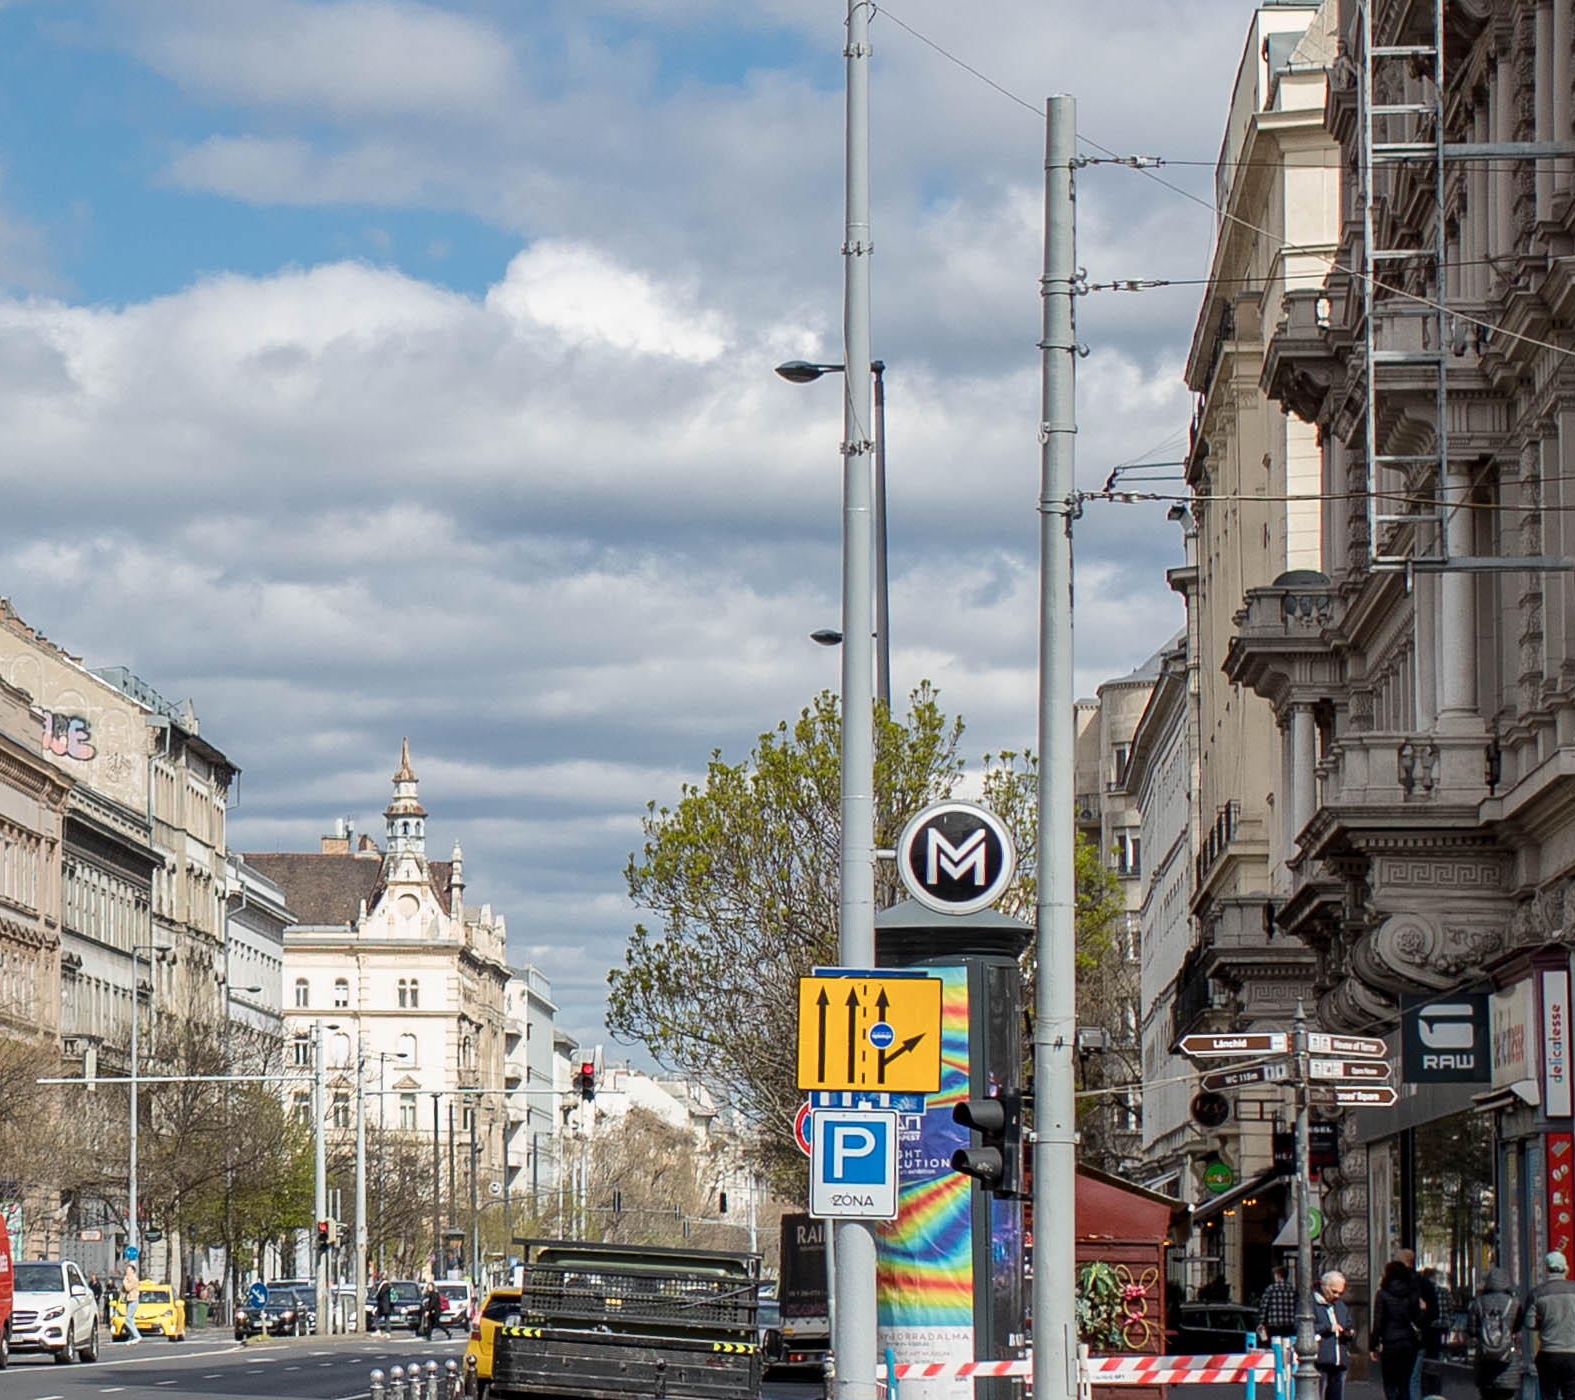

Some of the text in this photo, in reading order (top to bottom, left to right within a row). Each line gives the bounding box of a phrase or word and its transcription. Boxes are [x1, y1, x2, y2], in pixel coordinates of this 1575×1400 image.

[1548, 1003, 1563, 1084] delicatesse
[1422, 1054, 1475, 1070] RAW
[833, 1125, 877, 1179] P
[832, 1191, 875, 1207] ZÓNA
